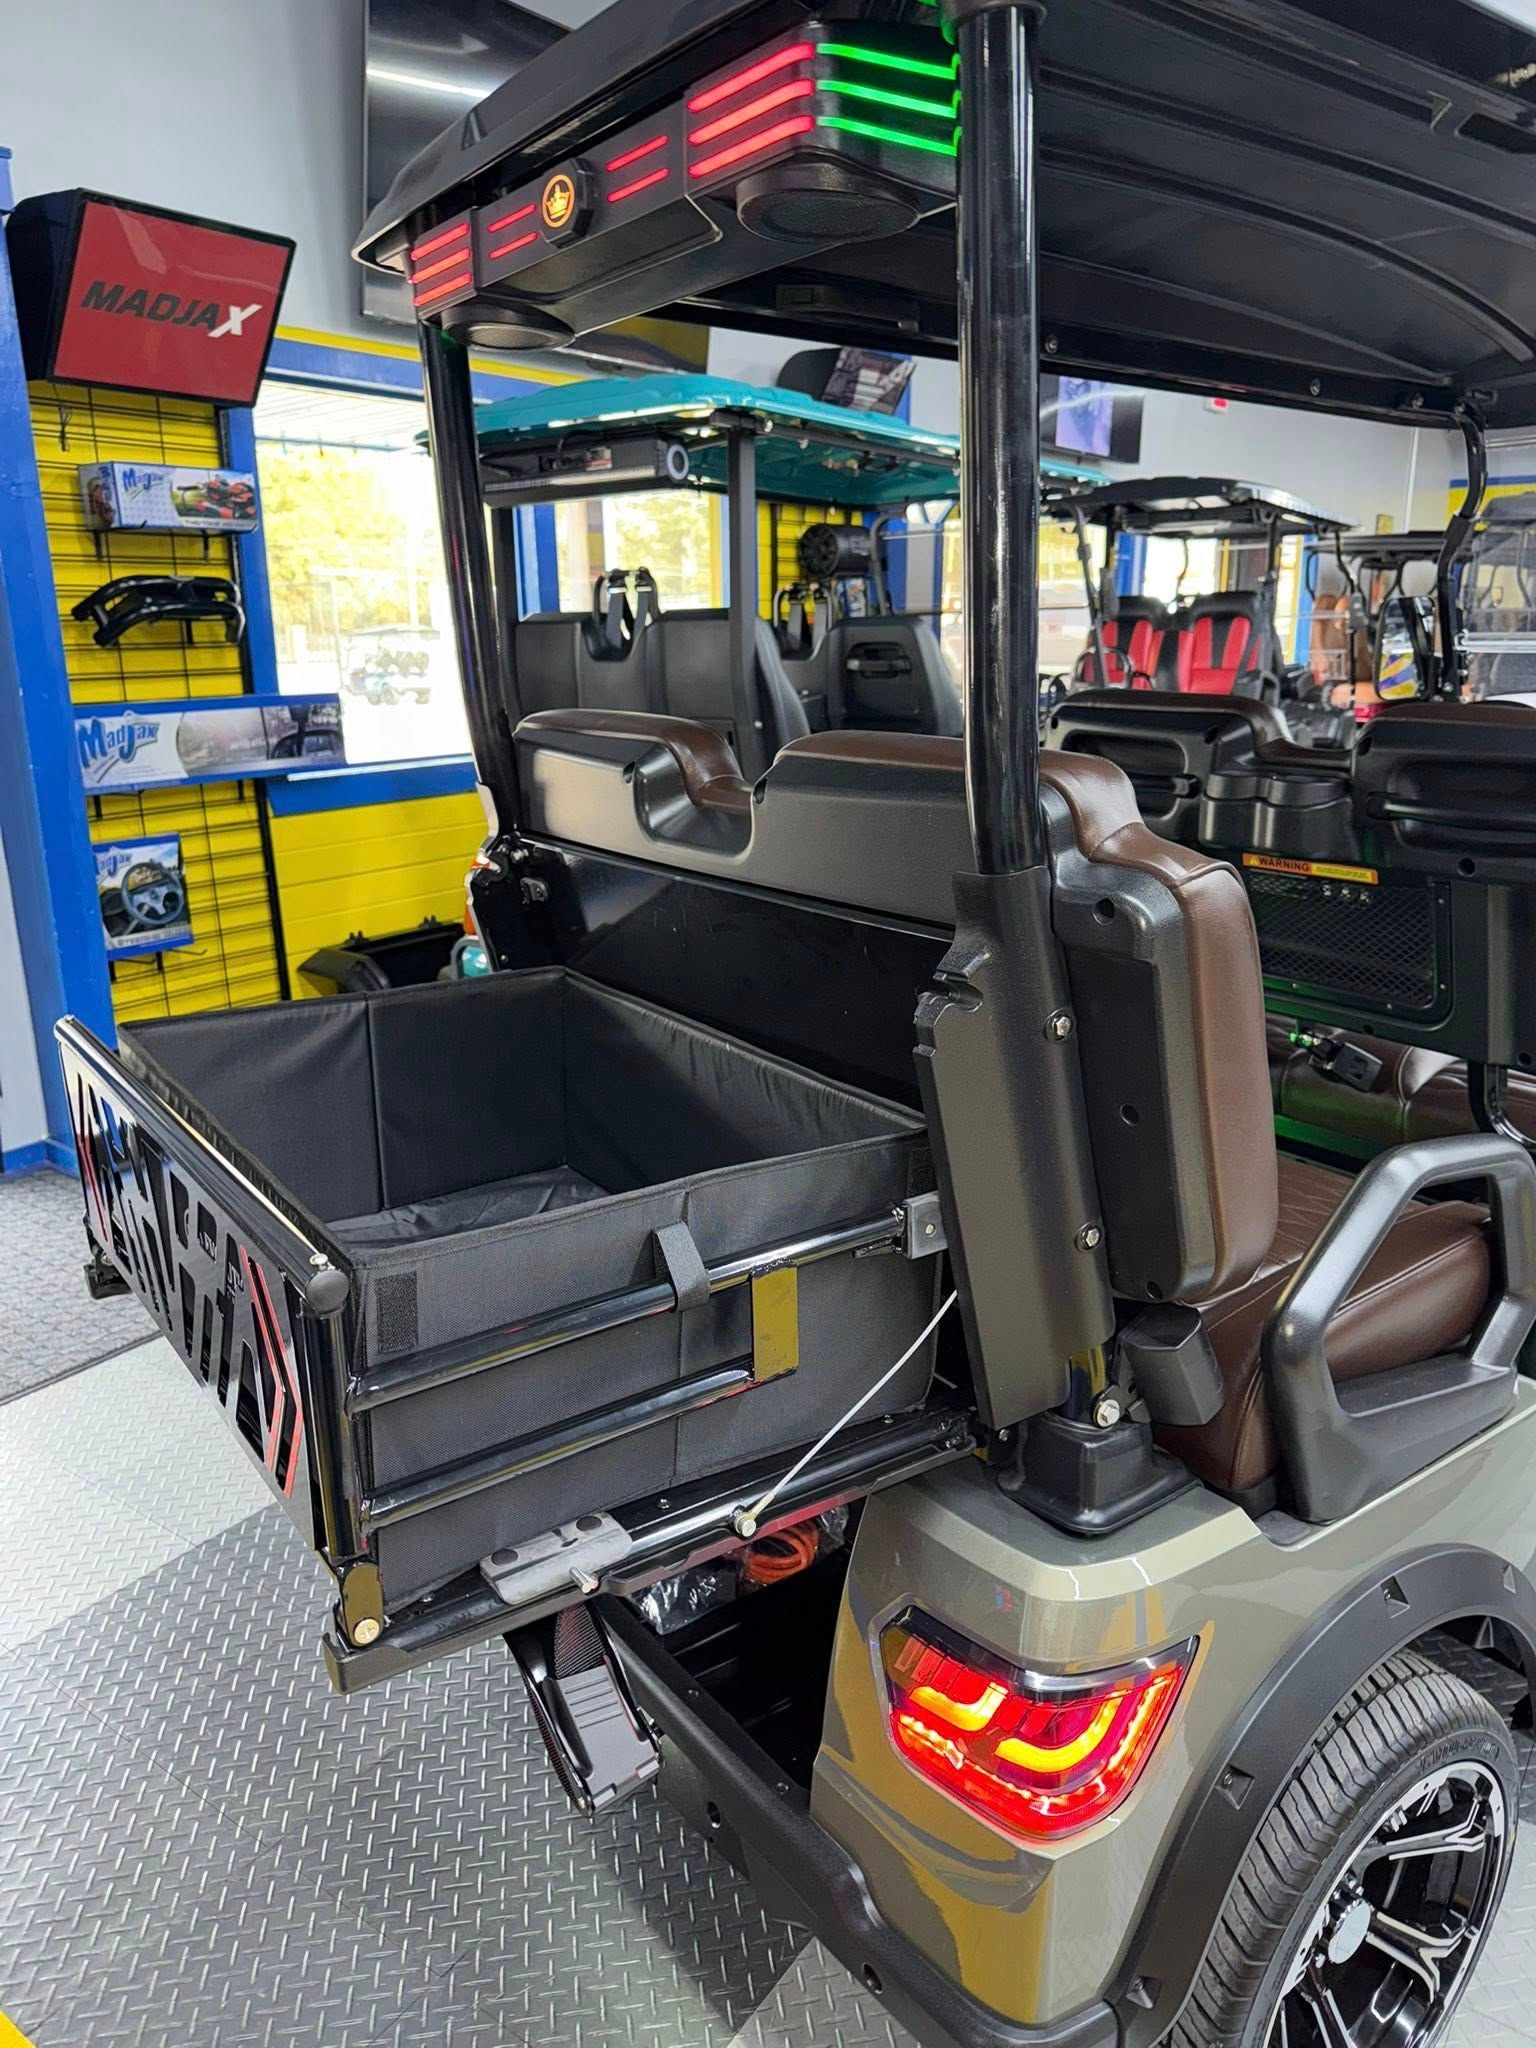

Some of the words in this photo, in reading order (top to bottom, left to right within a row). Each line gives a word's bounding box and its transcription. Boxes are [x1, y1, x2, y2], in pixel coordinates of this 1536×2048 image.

[81, 281, 262, 338] MADJAX
[78, 719, 158, 769] MadJax
[1258, 857, 1310, 872] WARNING
